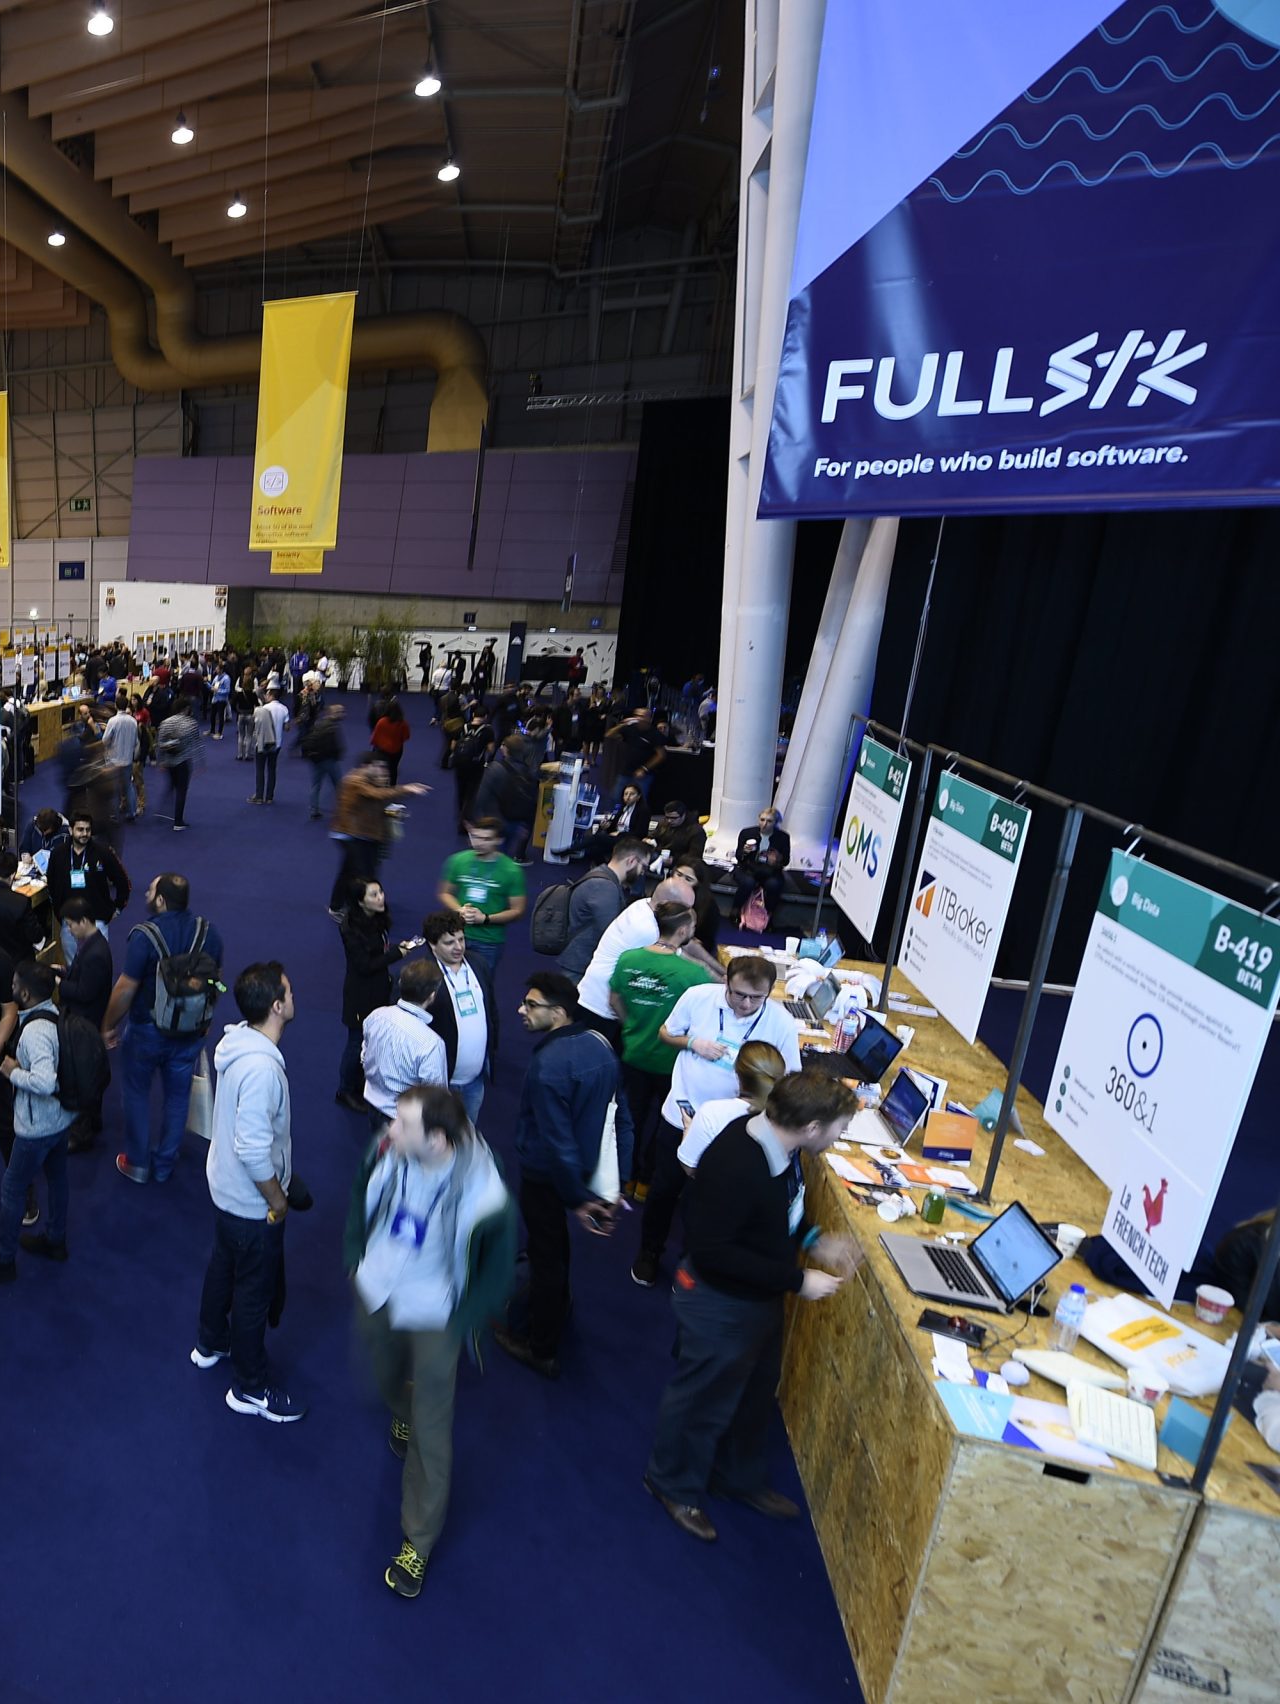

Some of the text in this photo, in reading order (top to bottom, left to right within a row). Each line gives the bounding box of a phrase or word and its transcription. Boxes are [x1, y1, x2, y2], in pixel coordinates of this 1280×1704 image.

[814, 443, 1189, 479] For people who build software.
[258, 505, 302, 516] Software
[846, 815, 882, 879] OMS
[990, 813, 1019, 842] B-420
[938, 886, 992, 949] ITBroker
[1131, 892, 1273, 973] Big Data B-419
[1237, 968, 1263, 994] BETA
[1105, 1065, 1158, 1134] 360&1
[1120, 1184, 1132, 1211] La
[1112, 1210, 1170, 1286] FRENCH TECH
